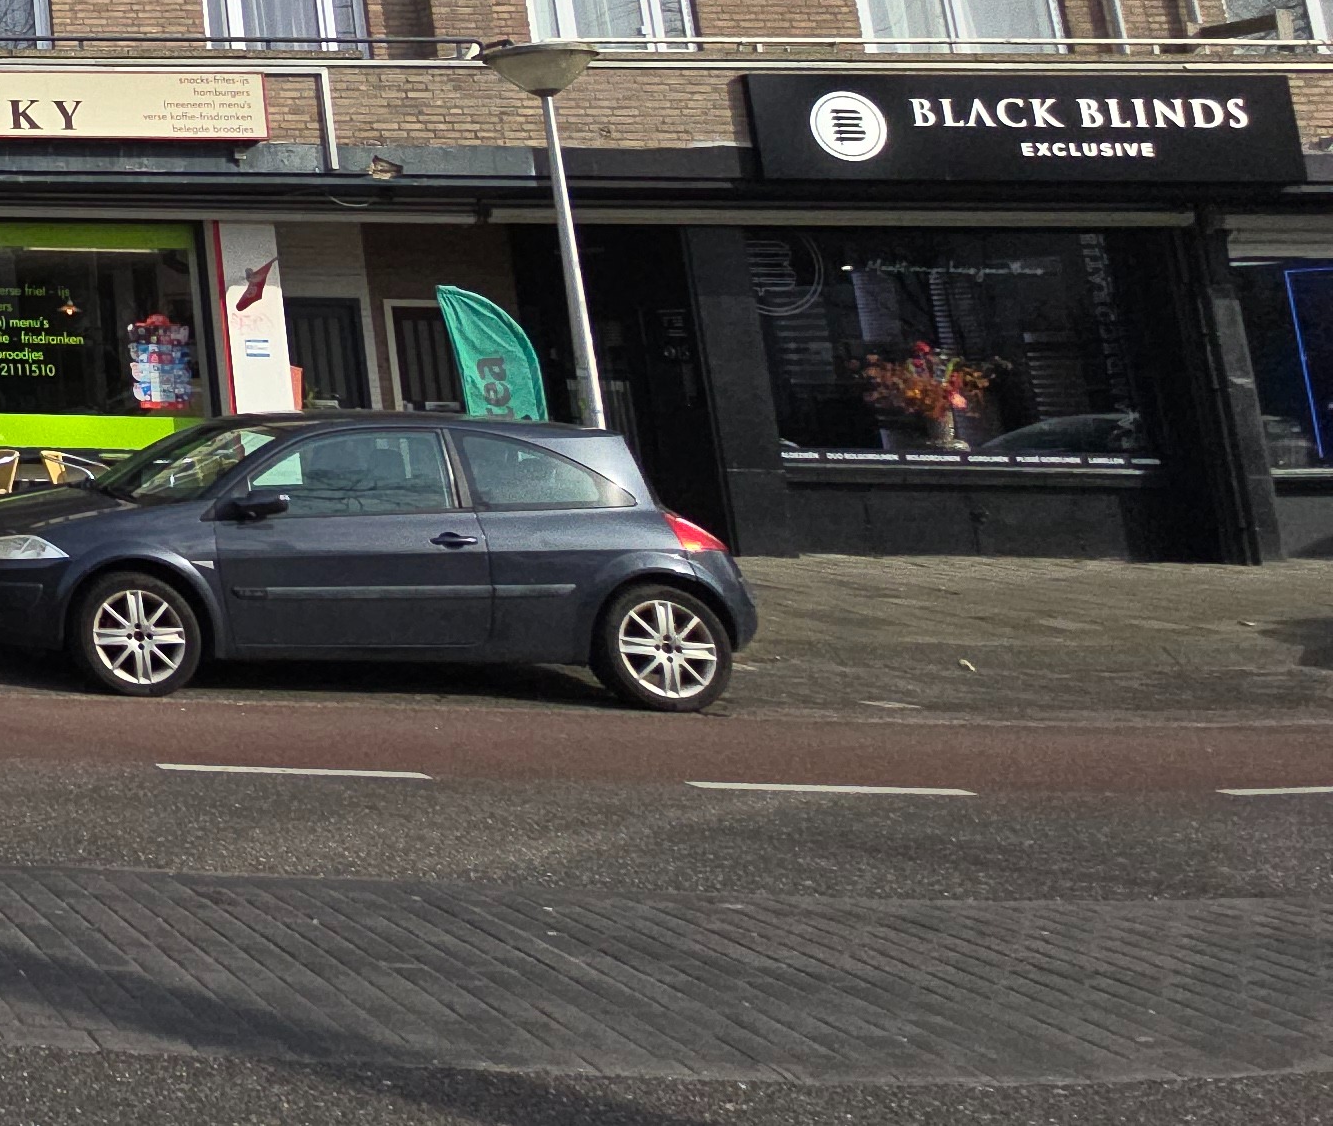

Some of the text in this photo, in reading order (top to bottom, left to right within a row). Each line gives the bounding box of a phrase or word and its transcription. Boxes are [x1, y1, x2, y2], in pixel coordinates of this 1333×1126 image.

[178, 75, 250, 86] snacks-frites-ijs
[193, 87, 251, 98] hamburgers
[163, 99, 252, 110] (meeneem) menu's
[170, 111, 253, 121] koffie-frisdranken
[909, 97, 1249, 129] BLACK BLINDS
[171, 123, 254, 135] belegde broodjes
[1020, 141, 1156, 158] EXCLUSIVE
[24, 284, 46, 296] friet
[58, 286, 70, 300] ijs
[9, 317, 50, 328] menu's
[21, 330, 85, 345] frisdranken
[0, 363, 56, 377] 2111510
